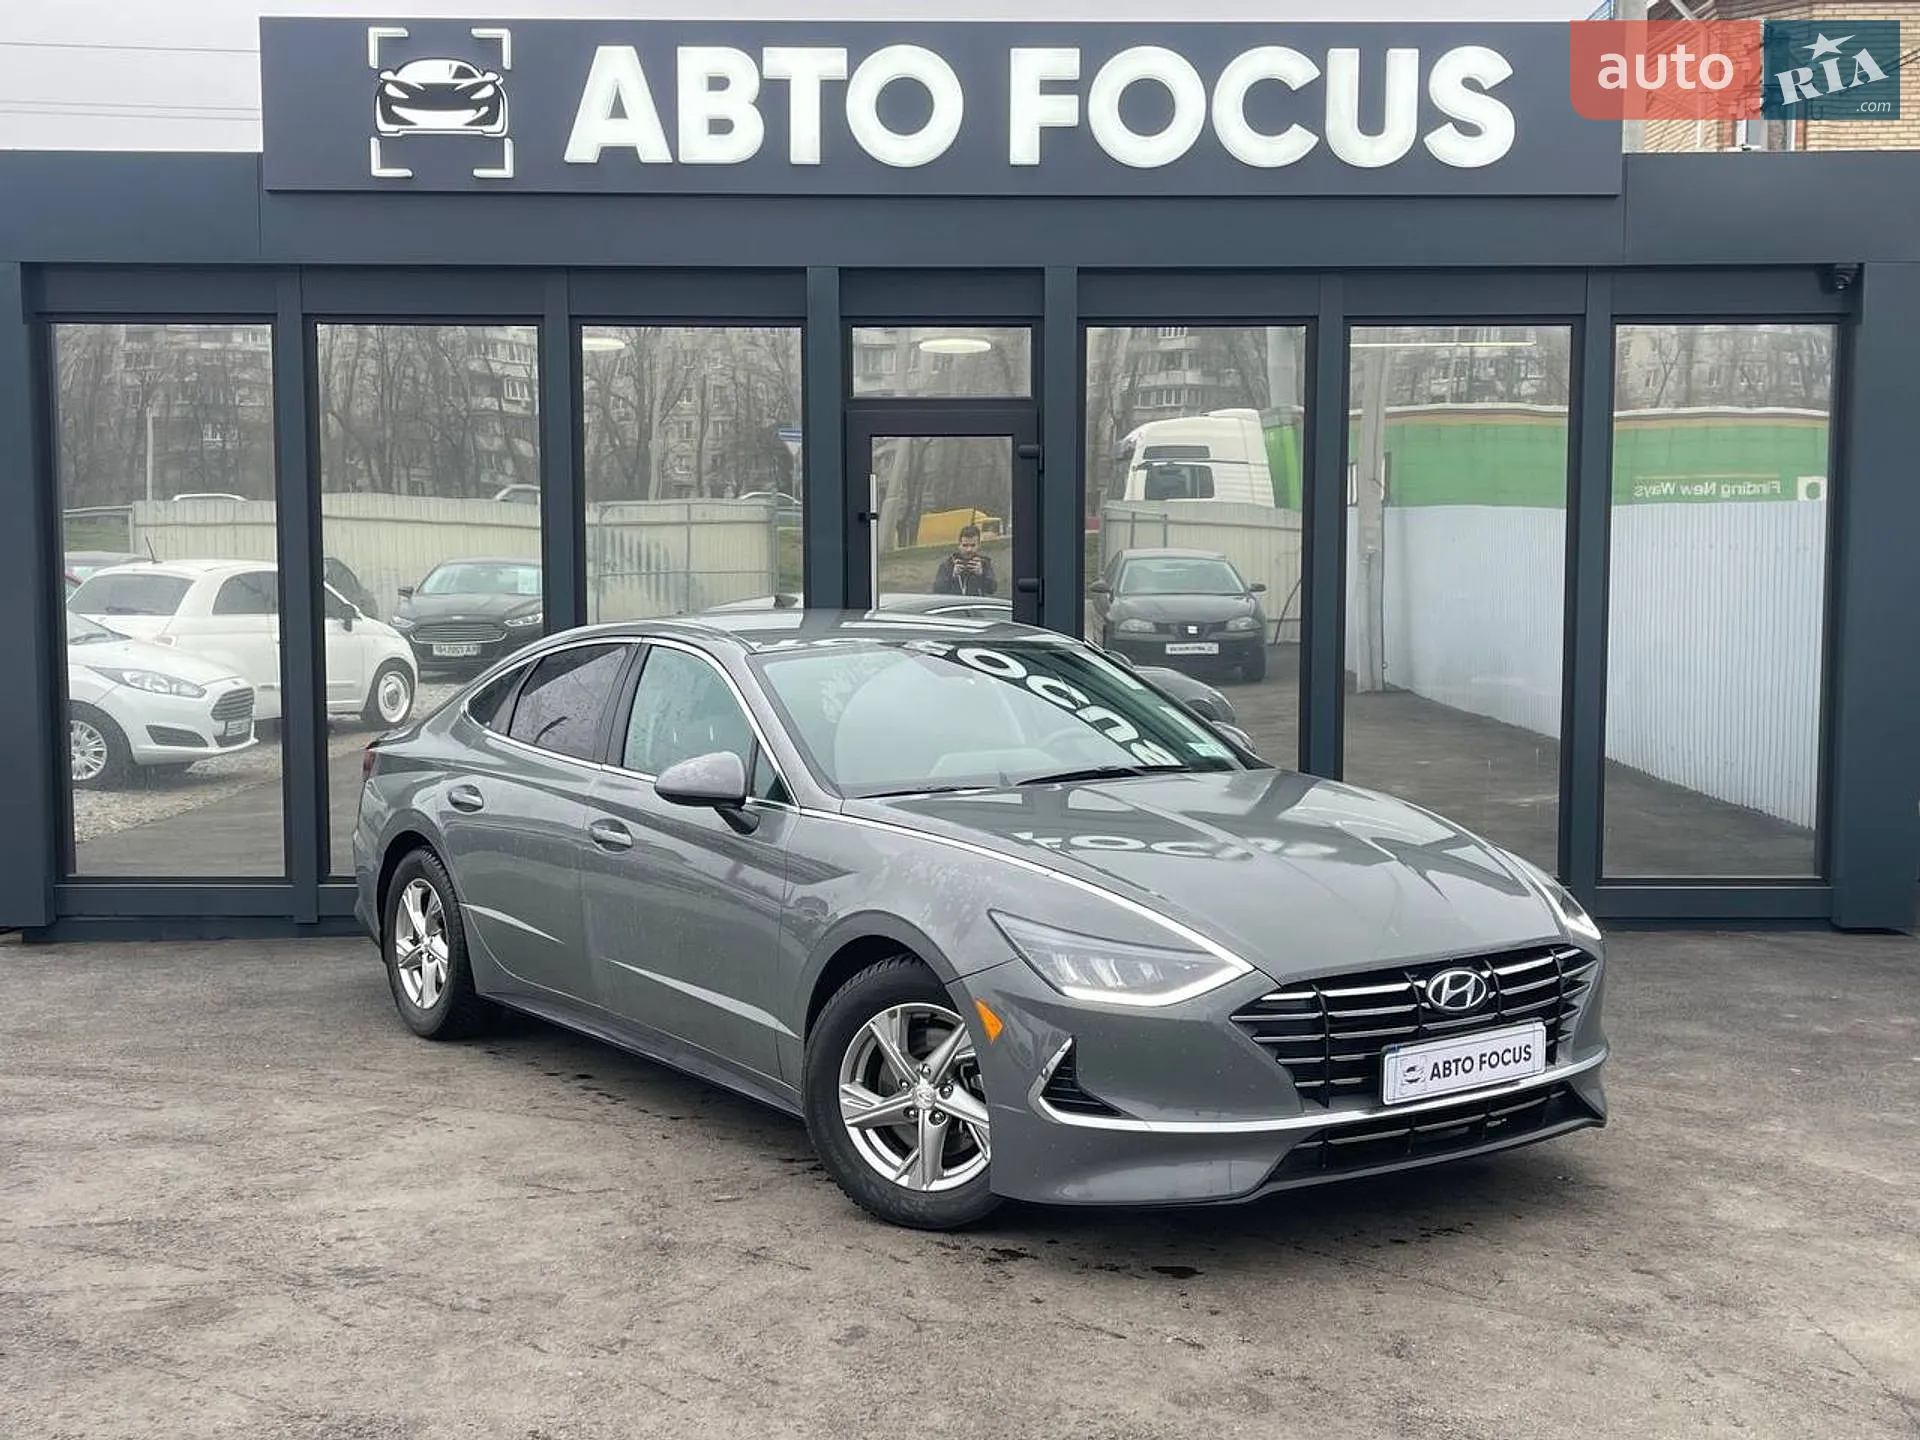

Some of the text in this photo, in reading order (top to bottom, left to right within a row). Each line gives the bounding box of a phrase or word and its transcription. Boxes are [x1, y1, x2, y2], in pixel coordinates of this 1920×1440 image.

[564, 44, 1515, 168] АВТО FOCUS
[1430, 1044, 1532, 1081] АВТО FOCUS
